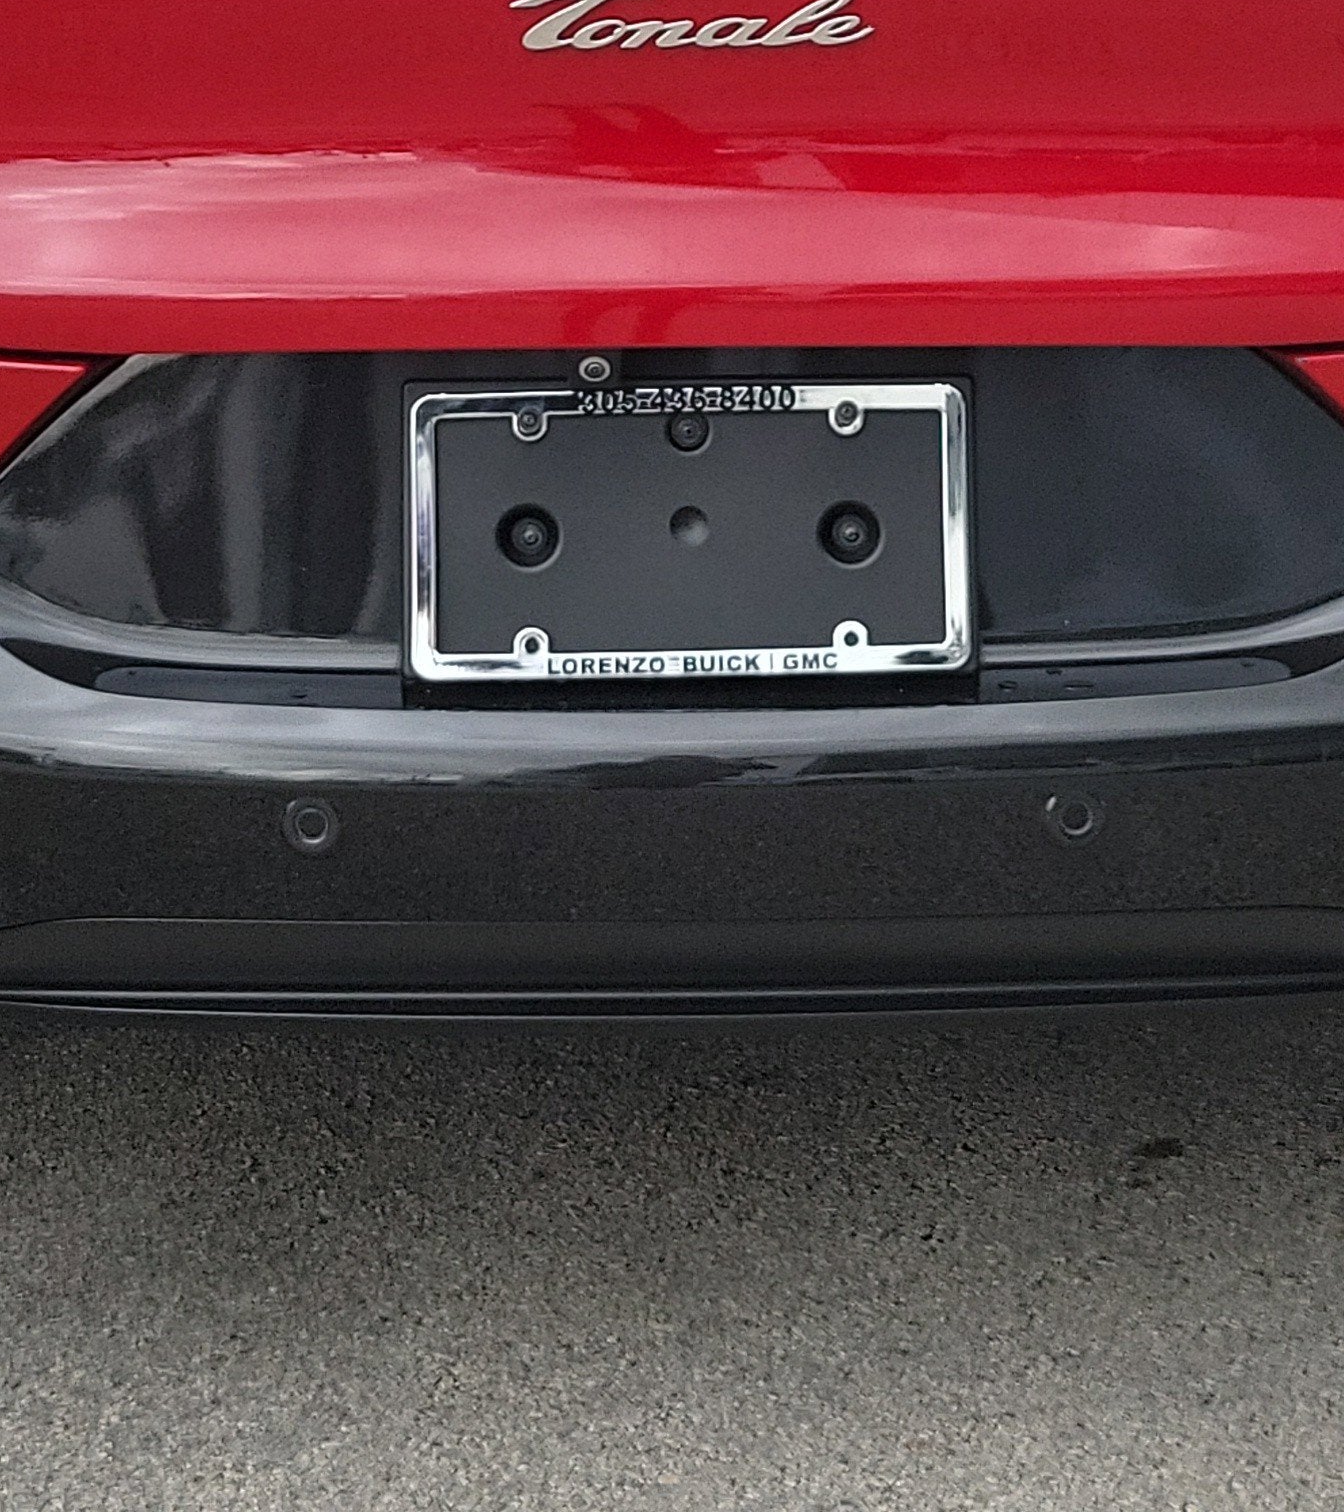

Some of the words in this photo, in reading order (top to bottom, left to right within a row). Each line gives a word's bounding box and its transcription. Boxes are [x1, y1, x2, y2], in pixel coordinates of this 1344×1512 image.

[578, 386, 796, 413] 305-436-8400
[547, 656, 666, 676] LORENZO
[682, 653, 761, 672] BUICK
[782, 651, 839, 670] GMC
